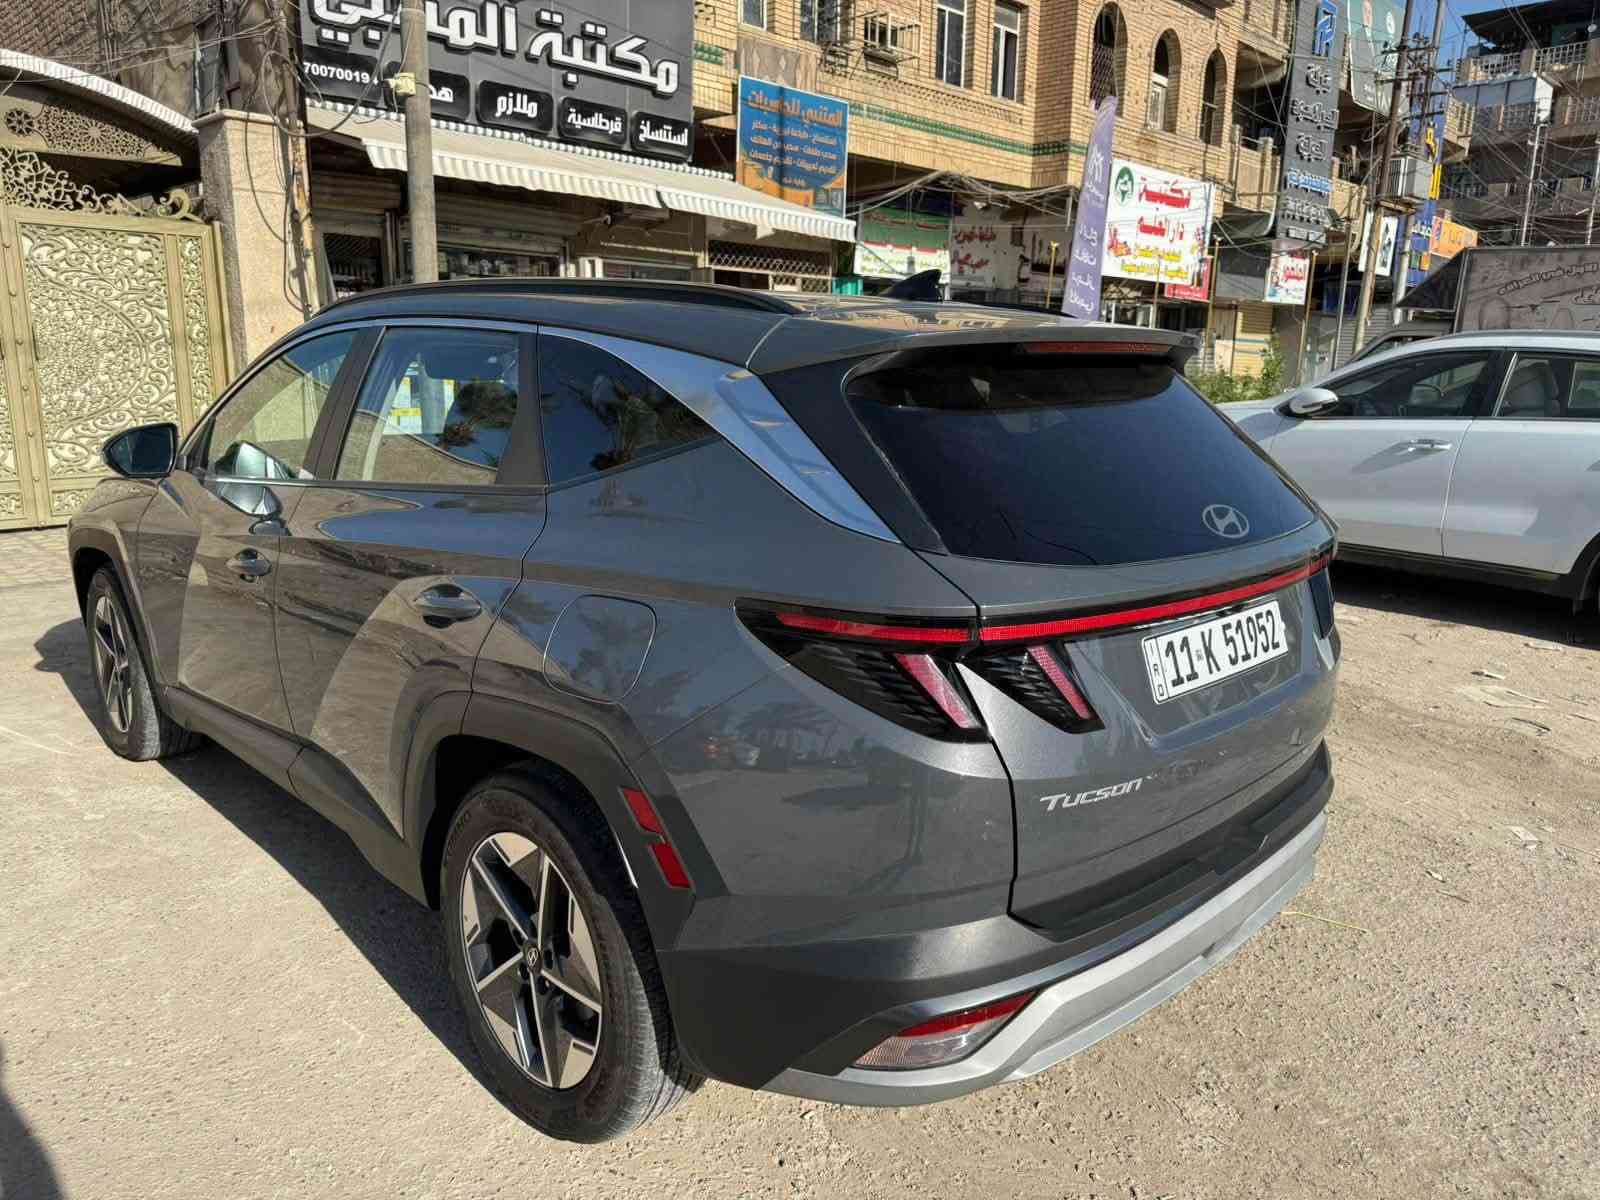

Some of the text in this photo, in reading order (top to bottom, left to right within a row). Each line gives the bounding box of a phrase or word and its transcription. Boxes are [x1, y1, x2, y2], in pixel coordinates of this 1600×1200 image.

[528, 9, 679, 94] مكتبة
[495, 92, 538, 117] ملازم
[567, 108, 622, 134] قرطاسية
[638, 119, 689, 146] استنساخ
[1138, 176, 1191, 211] مكتبة
[1165, 609, 1280, 687] 11 K 51952
